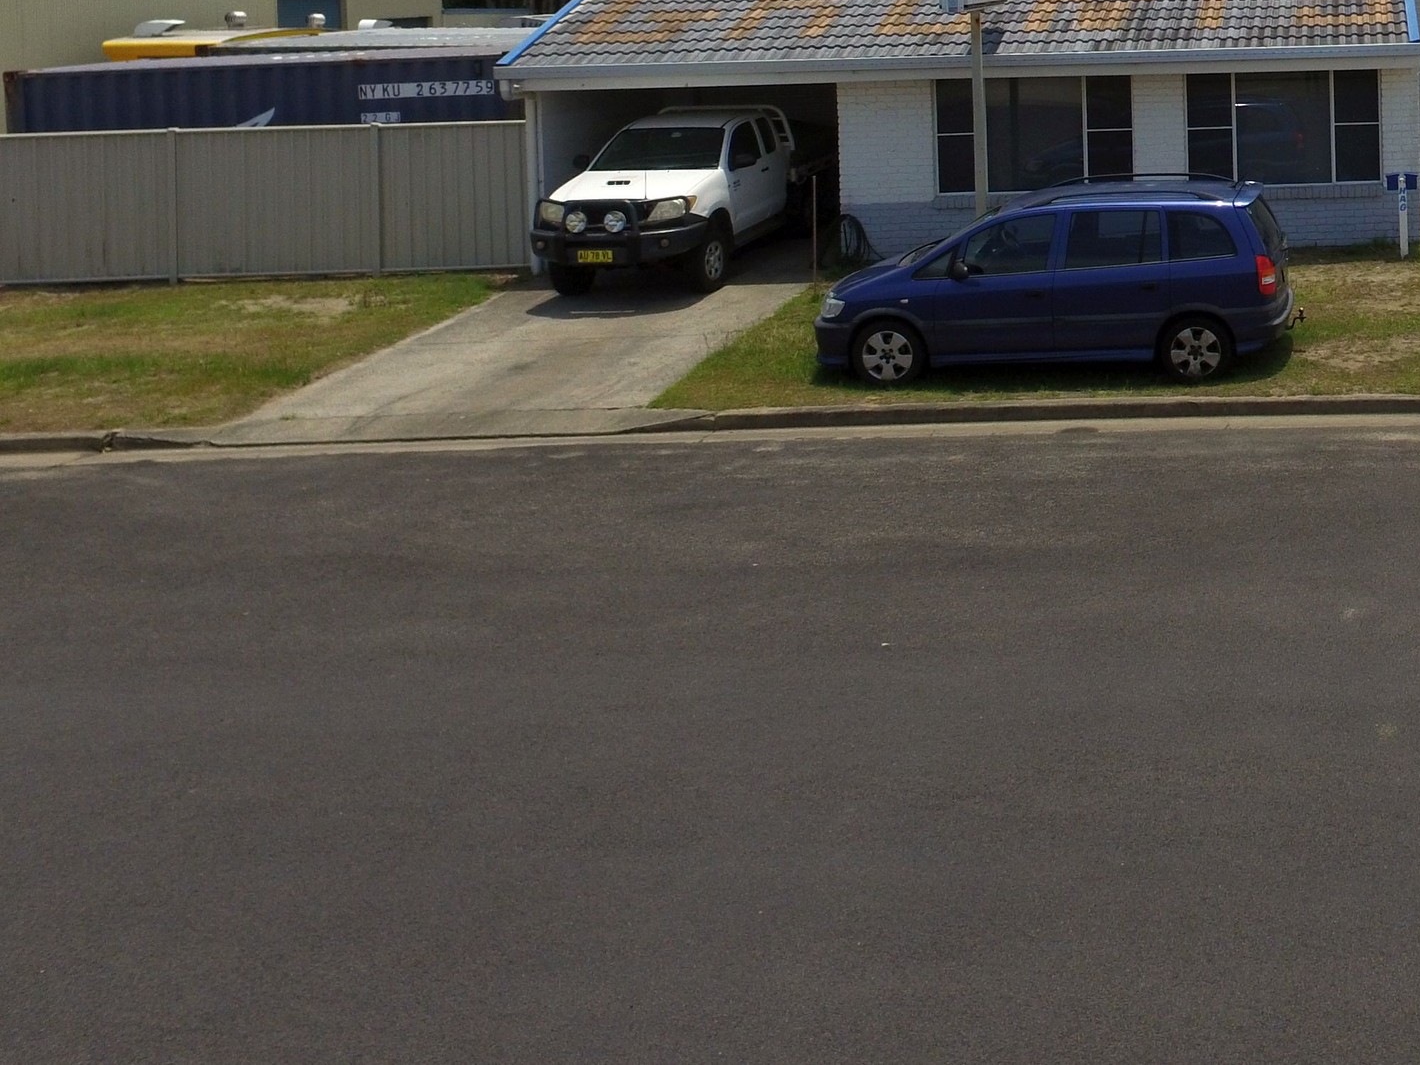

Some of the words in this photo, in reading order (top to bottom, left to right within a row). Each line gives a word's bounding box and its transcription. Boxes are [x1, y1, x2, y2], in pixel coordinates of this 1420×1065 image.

[359, 85, 400, 99] NYKU
[416, 81, 493, 96] 2637759
[1399, 187, 1407, 212] HAG
